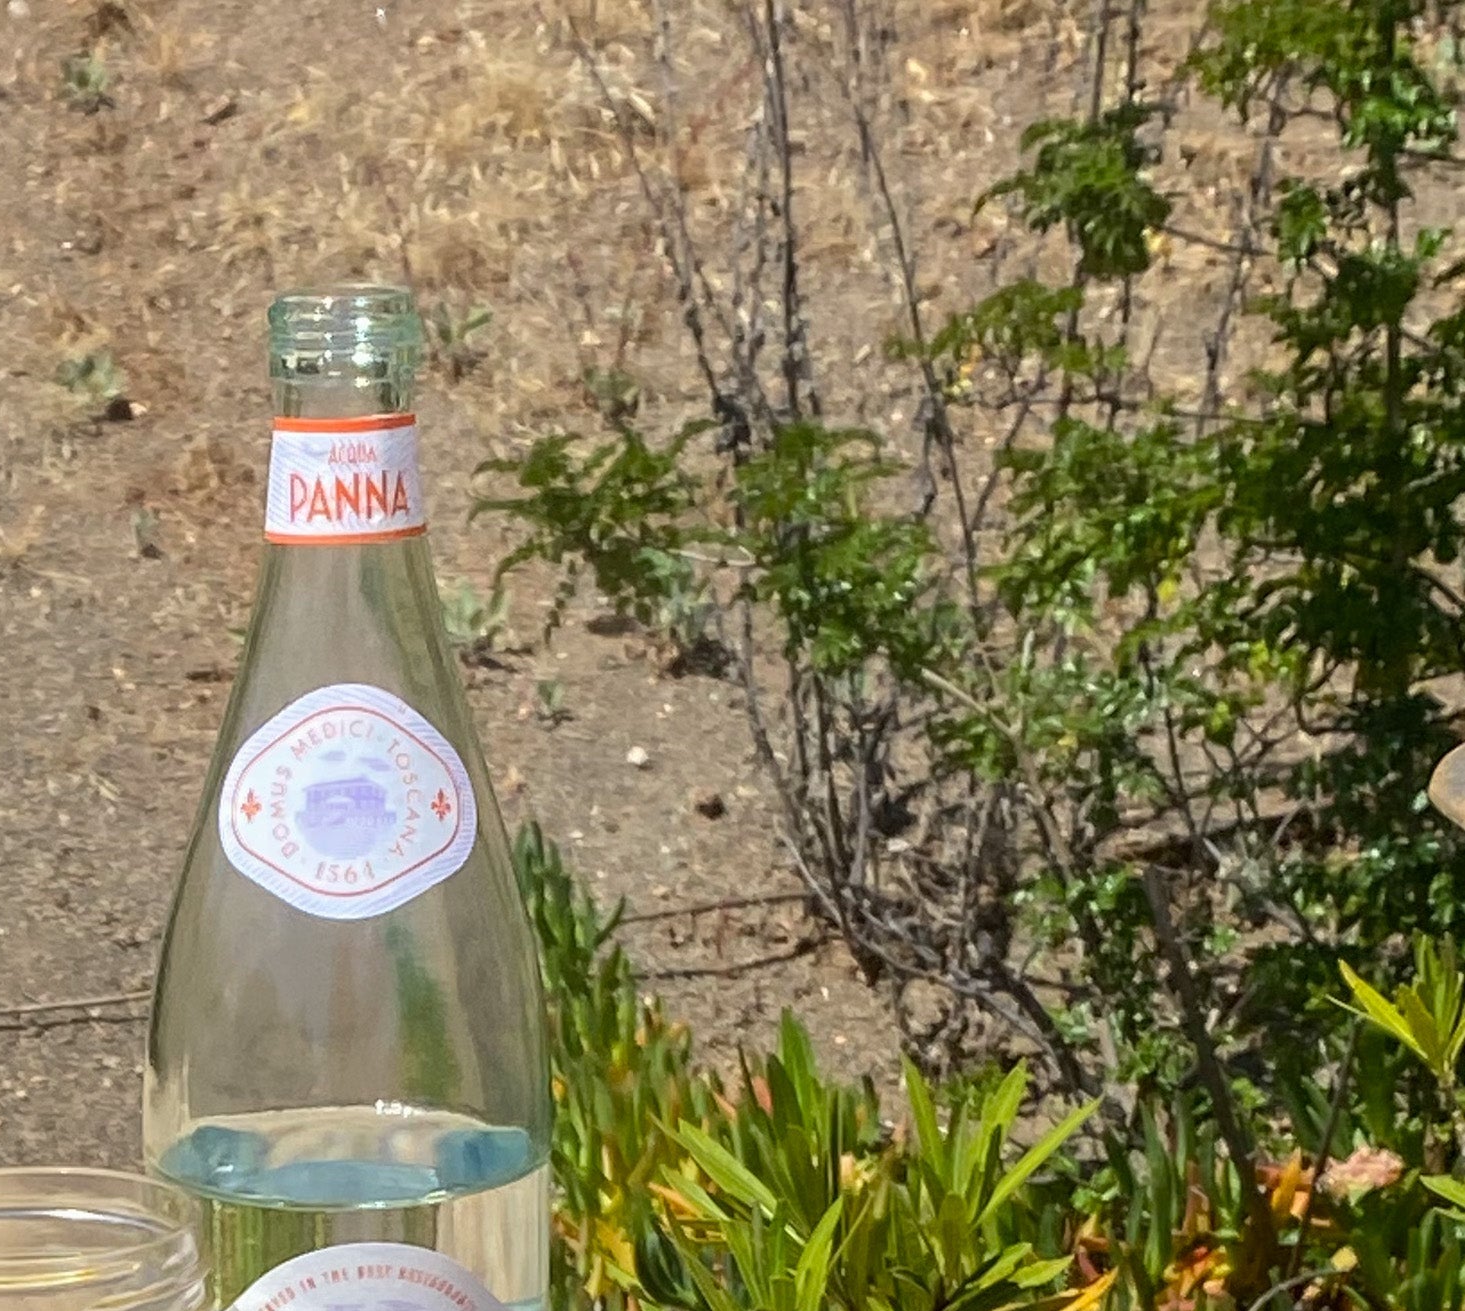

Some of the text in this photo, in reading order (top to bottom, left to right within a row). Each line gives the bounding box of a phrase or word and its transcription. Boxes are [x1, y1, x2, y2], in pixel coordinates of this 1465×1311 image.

[328, 440, 377, 464] ACQUA
[289, 469, 411, 523] PANNA
[269, 765, 300, 859] DOMUS
[289, 719, 374, 761] MEDICI
[386, 738, 422, 857] TOSCANA
